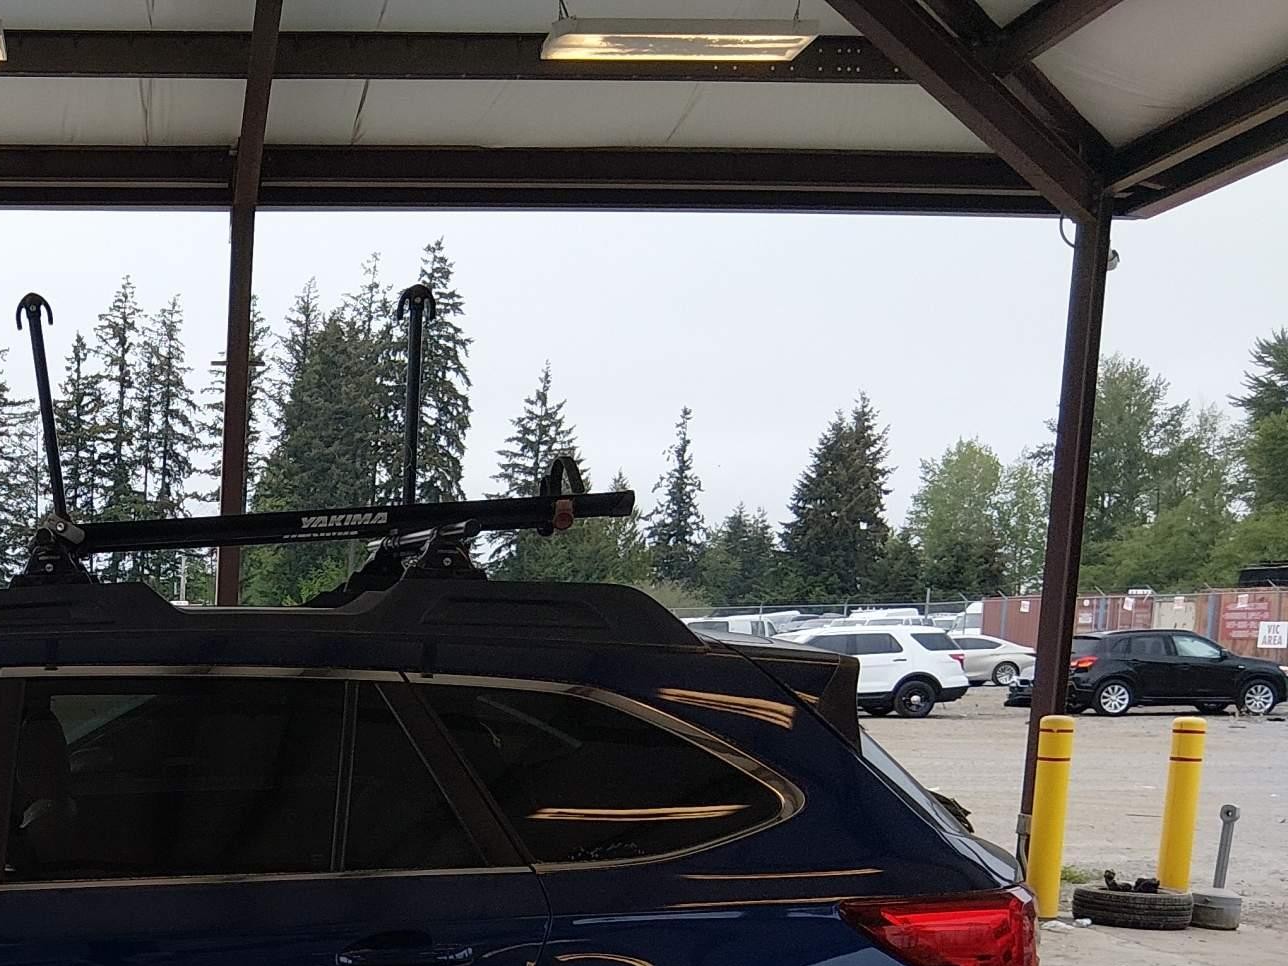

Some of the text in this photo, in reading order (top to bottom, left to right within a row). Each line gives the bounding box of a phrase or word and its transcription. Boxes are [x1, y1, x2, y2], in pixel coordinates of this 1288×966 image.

[301, 512, 388, 528] YAKIMA
[1267, 624, 1280, 634] VIC
[1262, 635, 1282, 645] AREA
